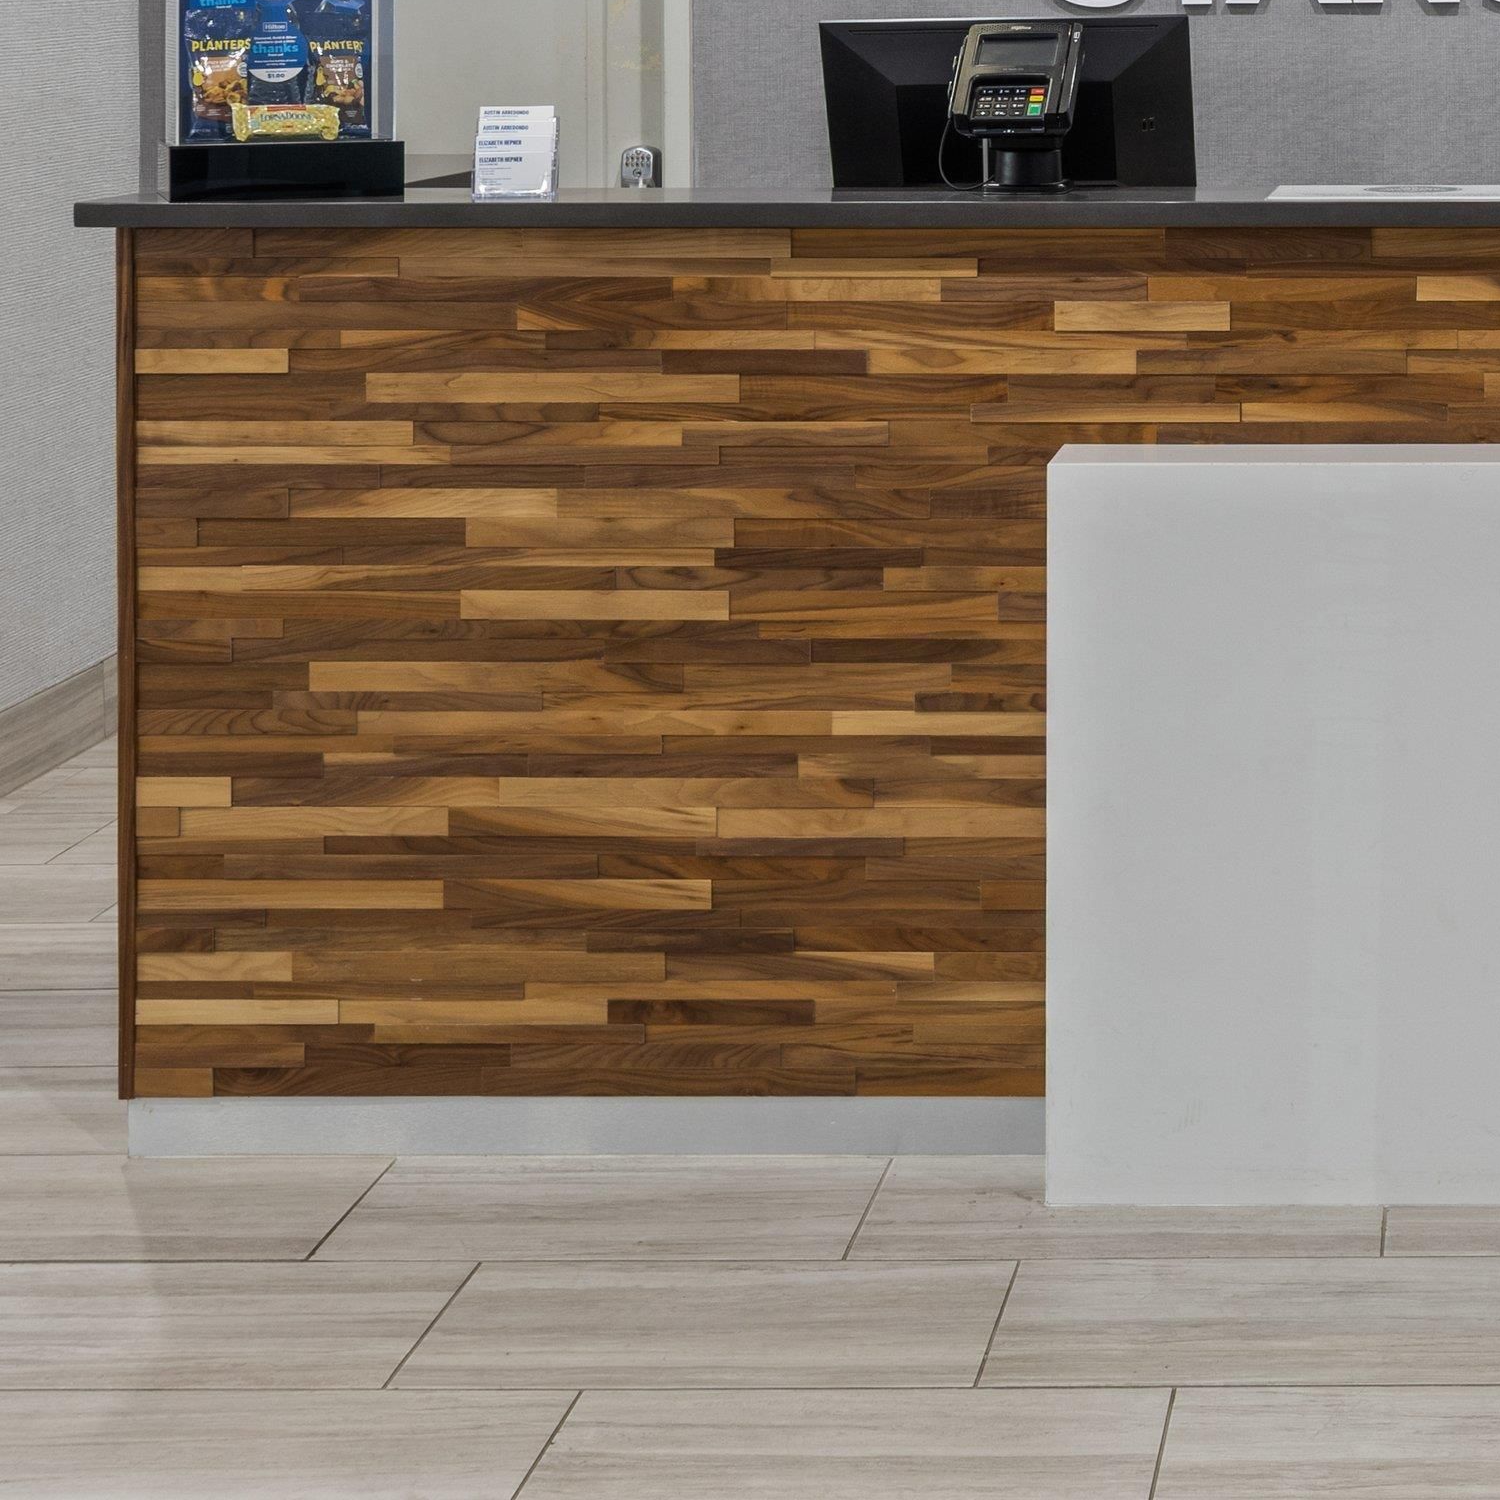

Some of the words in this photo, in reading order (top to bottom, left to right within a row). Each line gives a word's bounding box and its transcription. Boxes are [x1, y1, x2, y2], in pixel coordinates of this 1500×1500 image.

[191, 38, 251, 52] PLANTERS
[252, 43, 299, 54] thanks
[309, 40, 364, 53] PLANTERS
